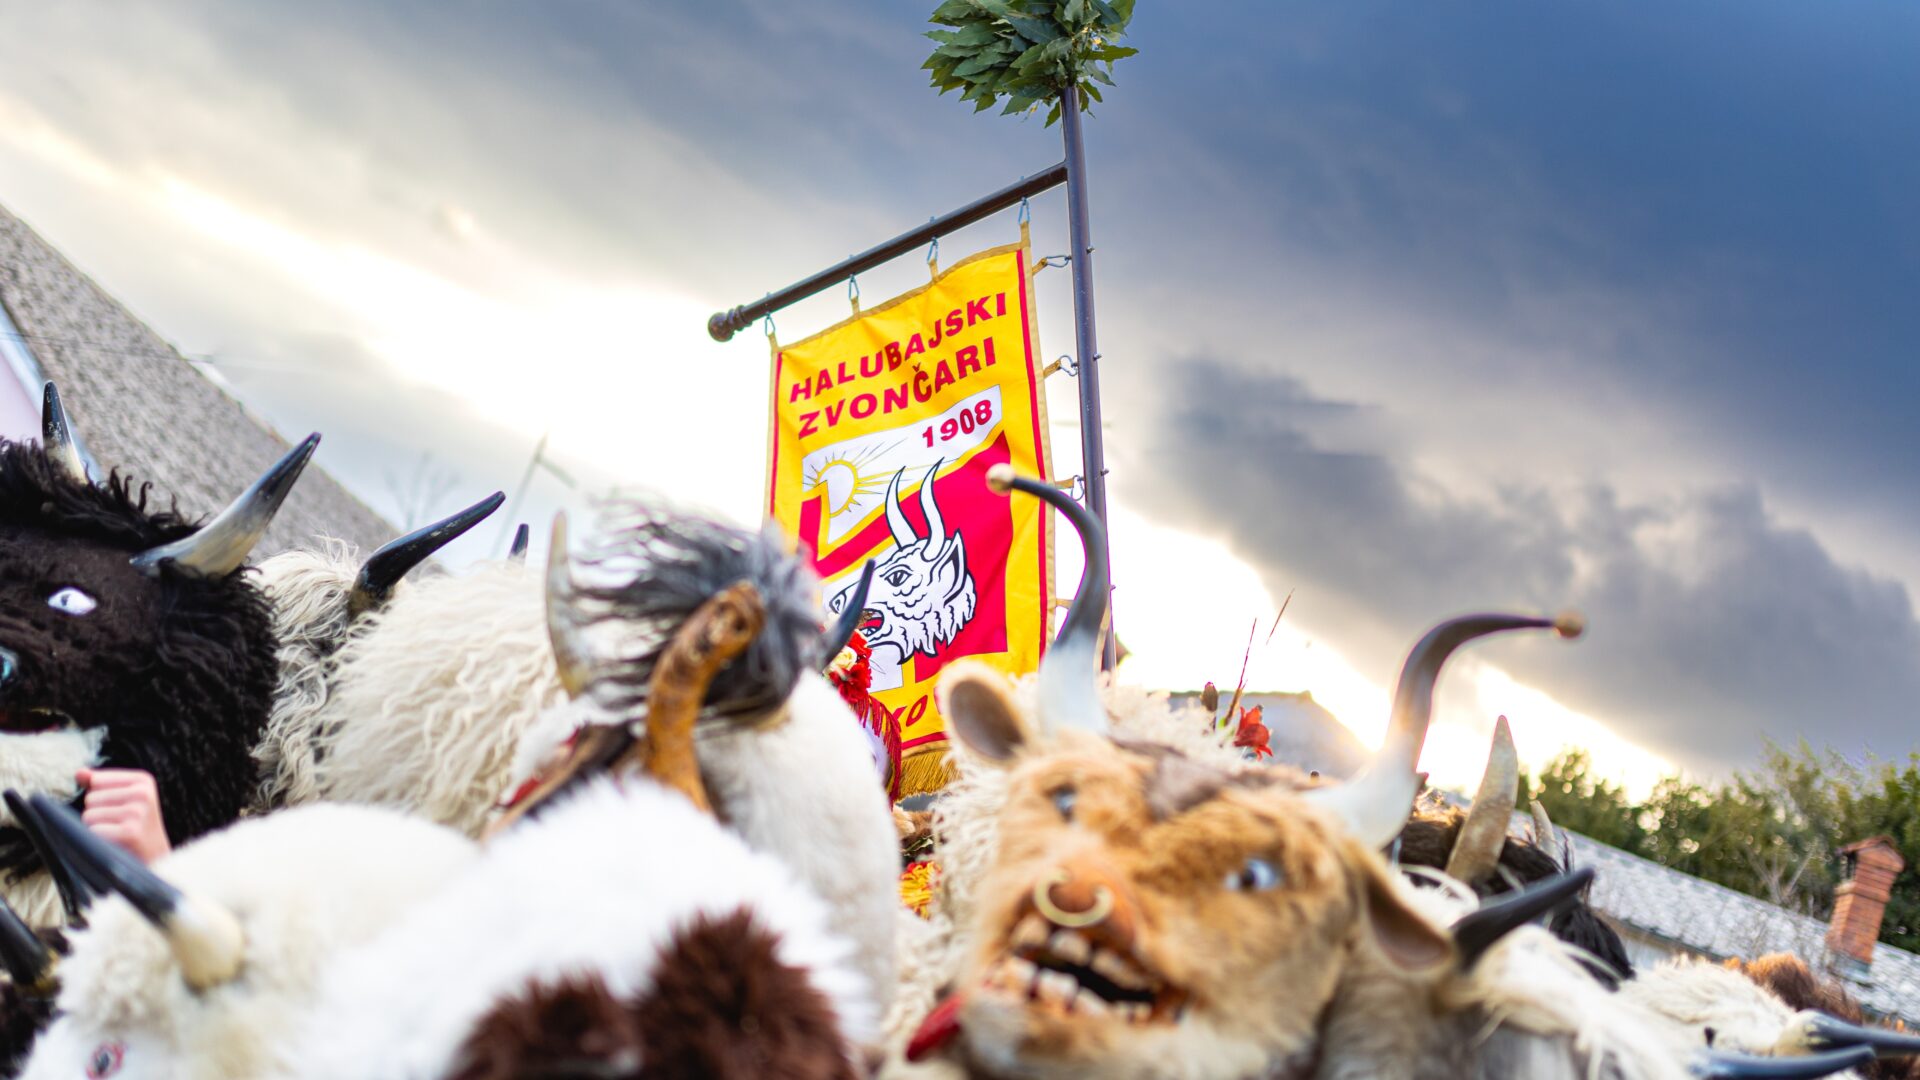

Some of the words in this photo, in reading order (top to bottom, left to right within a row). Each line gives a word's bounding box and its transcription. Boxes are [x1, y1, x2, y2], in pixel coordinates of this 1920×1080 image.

[789, 292, 1007, 404] HALUBAJSKI
[798, 336, 997, 440] ZVONČARI
[922, 399, 993, 448] 1908
